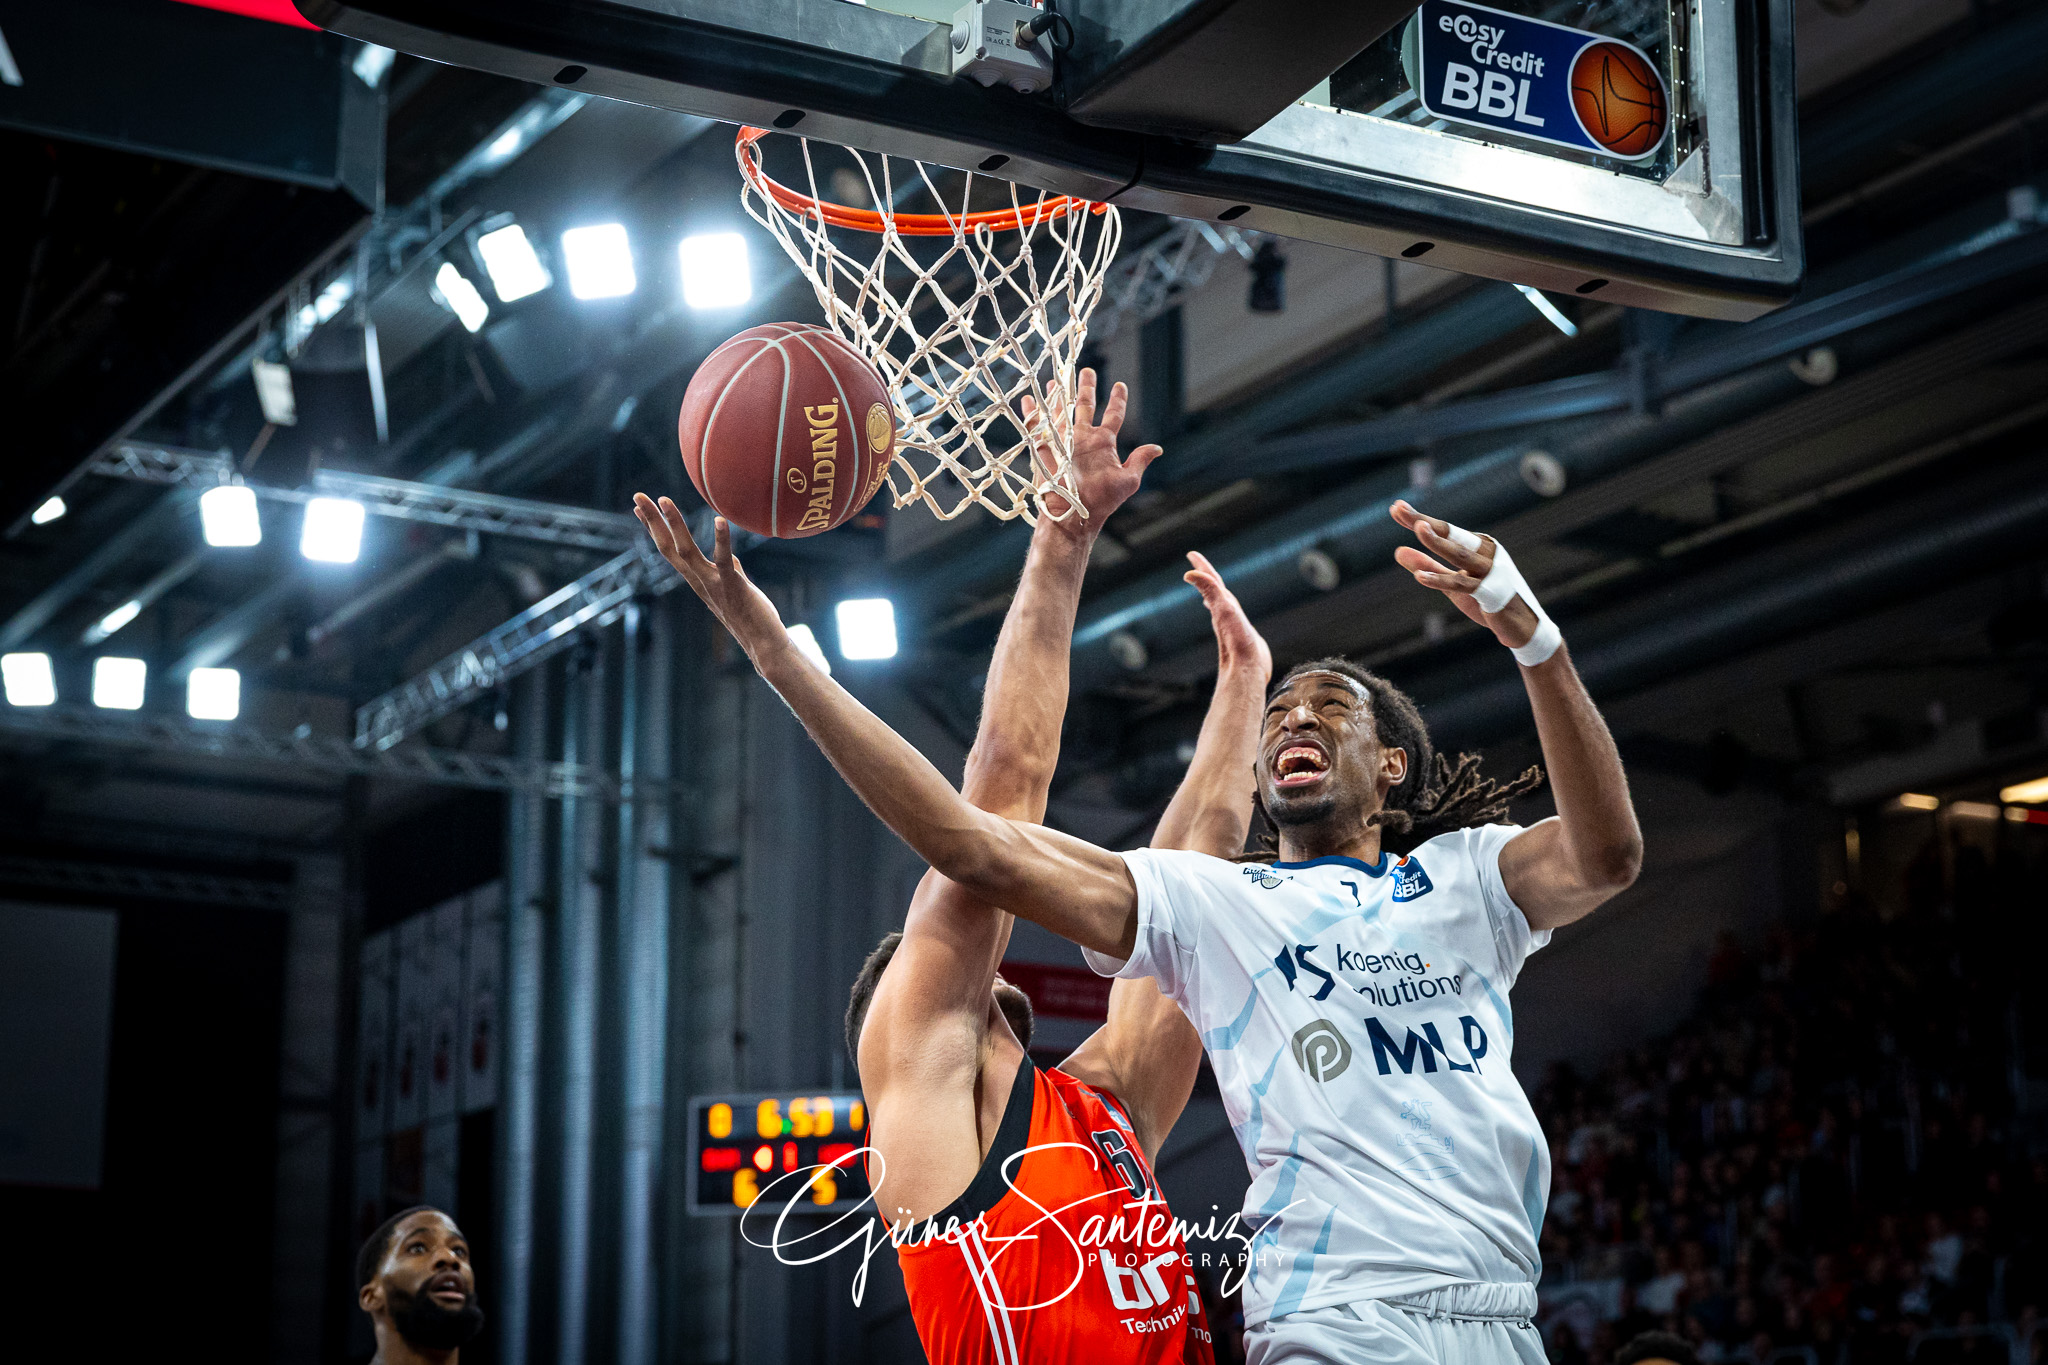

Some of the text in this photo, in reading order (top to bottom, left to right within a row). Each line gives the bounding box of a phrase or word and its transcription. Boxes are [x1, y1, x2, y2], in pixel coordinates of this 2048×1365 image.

[1471, 41, 1545, 78] Credit
[1441, 61, 1545, 127] BBL
[796, 404, 839, 531] SPALDING
[1394, 879, 1427, 898] BBL
[1353, 974, 1462, 1007] olutions
[1364, 1015, 1488, 1076] MLP
[810, 1166, 837, 1206] 5
[1091, 1129, 1161, 1204] 6
